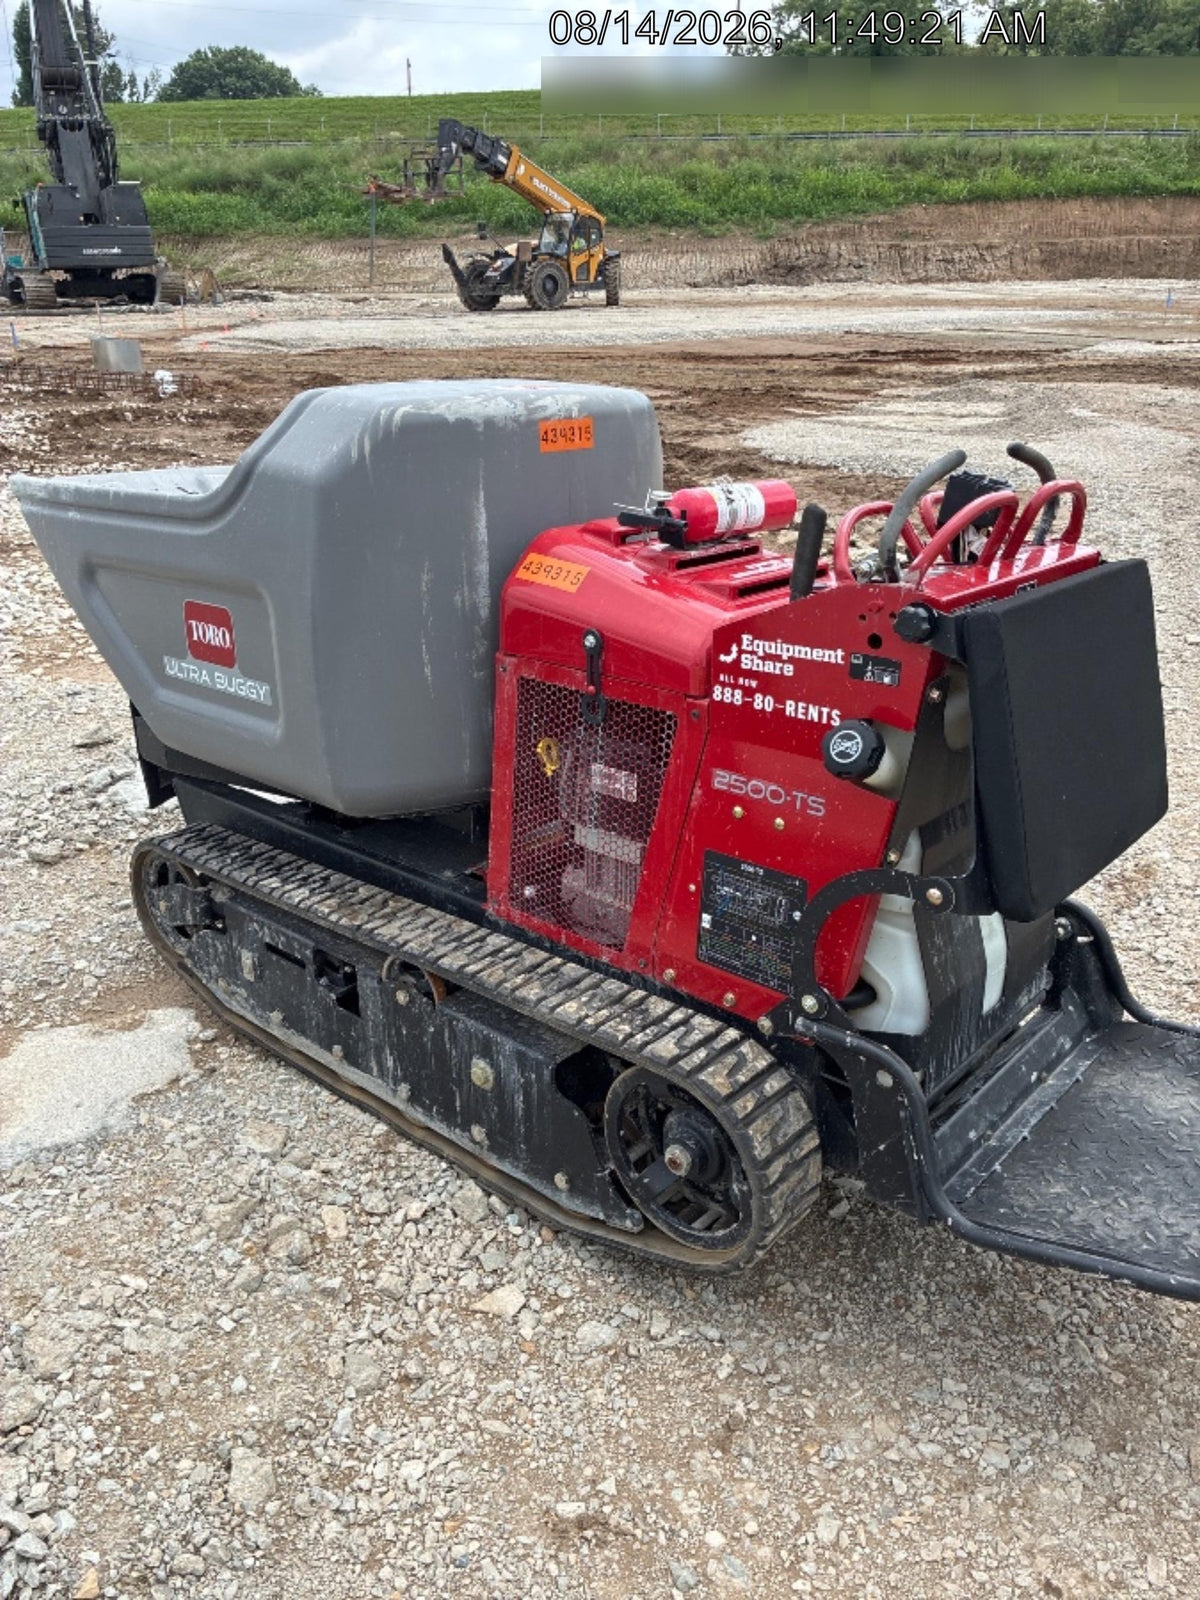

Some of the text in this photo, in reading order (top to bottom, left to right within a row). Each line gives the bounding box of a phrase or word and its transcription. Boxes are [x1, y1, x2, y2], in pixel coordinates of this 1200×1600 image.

[522, 561, 584, 586] 439315
[188, 620, 231, 649] TORO
[741, 635, 845, 664] Equipment
[165, 657, 266, 701] ULTRA BUGGY
[741, 655, 794, 677] Share
[712, 686, 841, 726] 888-80-RENTS
